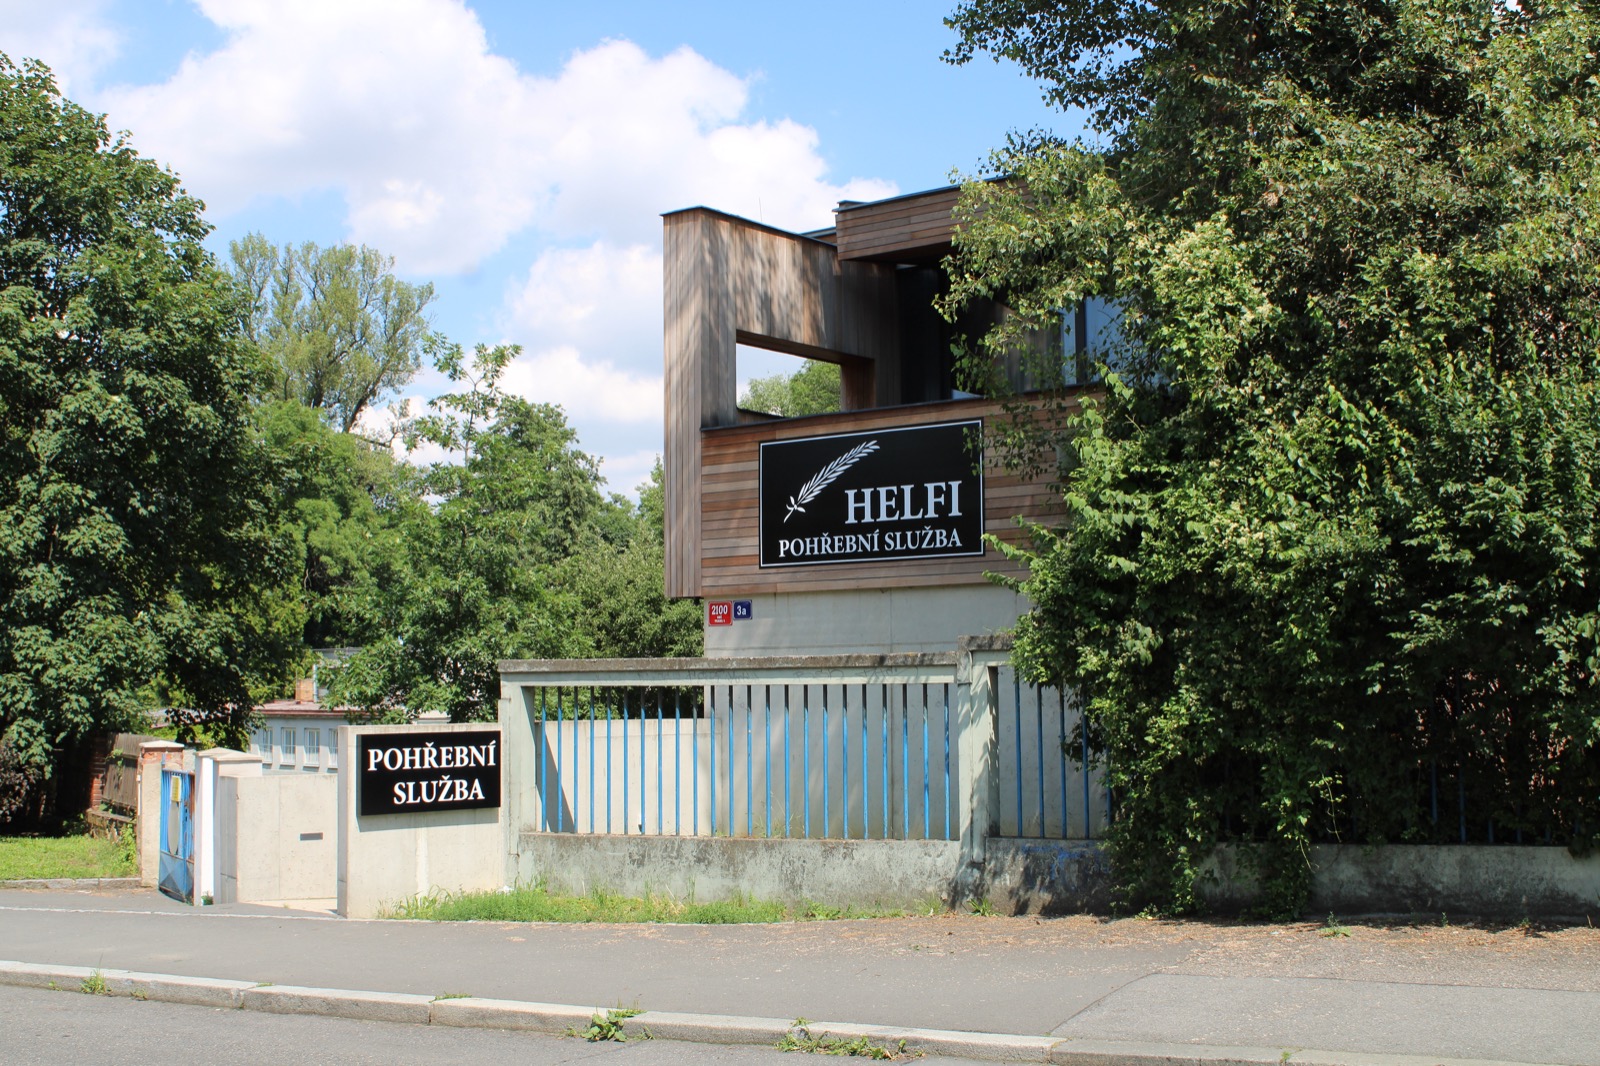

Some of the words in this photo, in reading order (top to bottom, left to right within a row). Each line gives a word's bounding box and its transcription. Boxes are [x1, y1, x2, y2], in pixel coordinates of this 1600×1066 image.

[844, 480, 963, 525] HELFI
[778, 528, 880, 558] POHŘEBNÍ
[884, 525, 963, 551] SLUŽBA
[711, 604, 728, 615] 2100
[736, 605, 747, 616] 3a
[367, 739, 497, 772] POHŘEBNÍ
[393, 774, 485, 805] SLUŽBA
